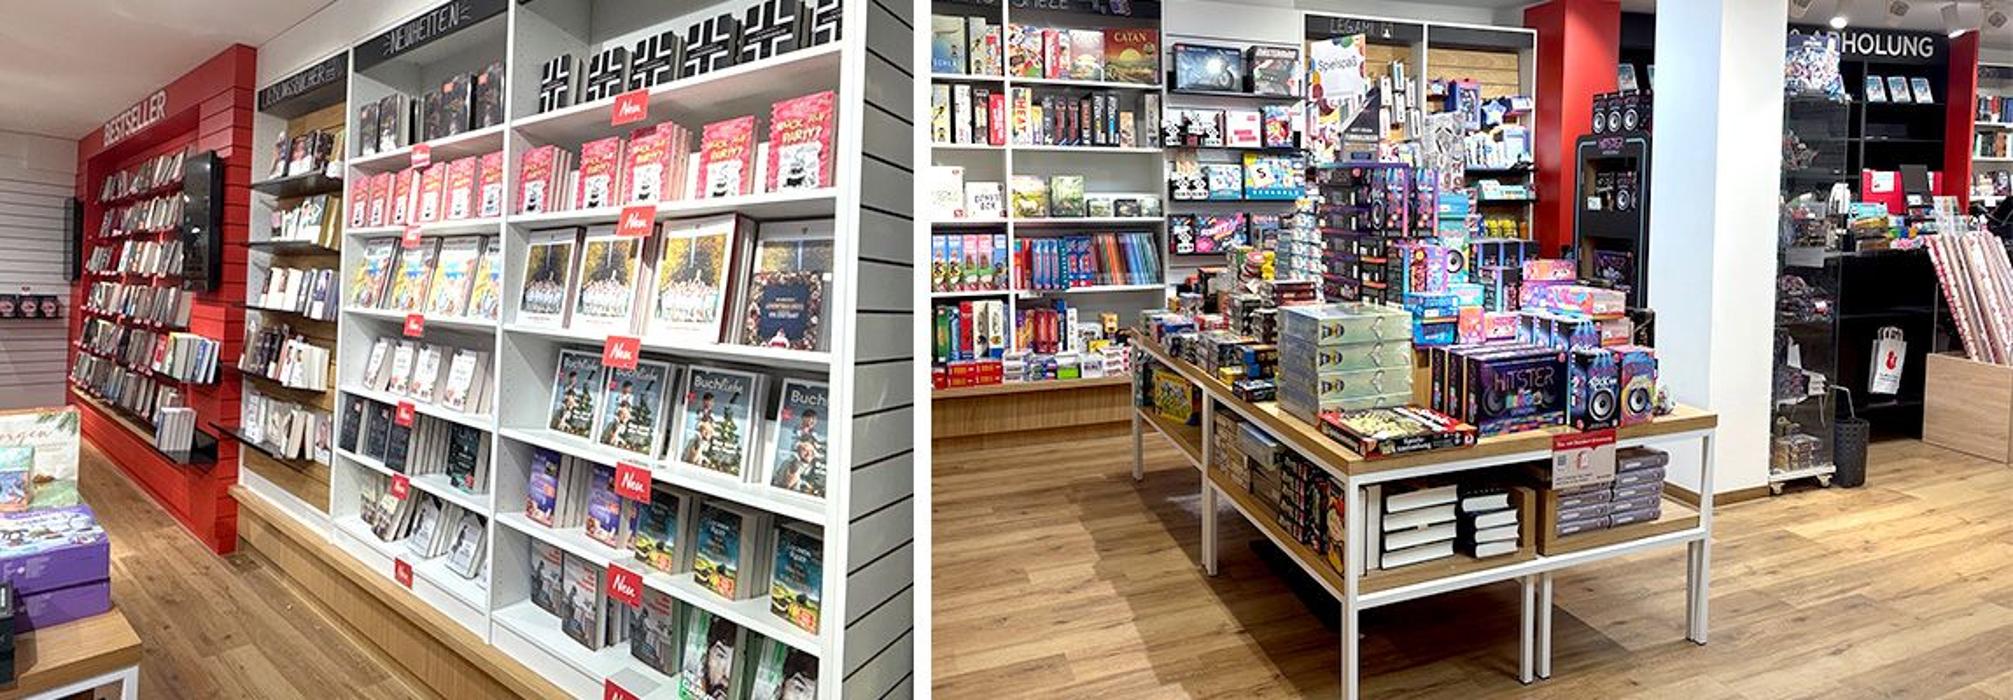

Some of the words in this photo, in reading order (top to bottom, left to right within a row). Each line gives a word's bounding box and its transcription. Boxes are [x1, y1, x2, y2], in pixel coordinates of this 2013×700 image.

[389, 2, 460, 54] NEUHEITEN
[1114, 31, 1147, 43] CATAN
[1330, 18, 1376, 38] LEGAMI
[104, 90, 167, 147] BESTSELLER
[619, 100, 641, 117] Neu
[624, 211, 647, 230] Neu
[609, 342, 632, 360] Neu
[694, 375, 744, 395] Buchliebe
[1494, 366, 1555, 392] HITSTER
[620, 472, 645, 493] Neu
[612, 572, 636, 598] Neu
